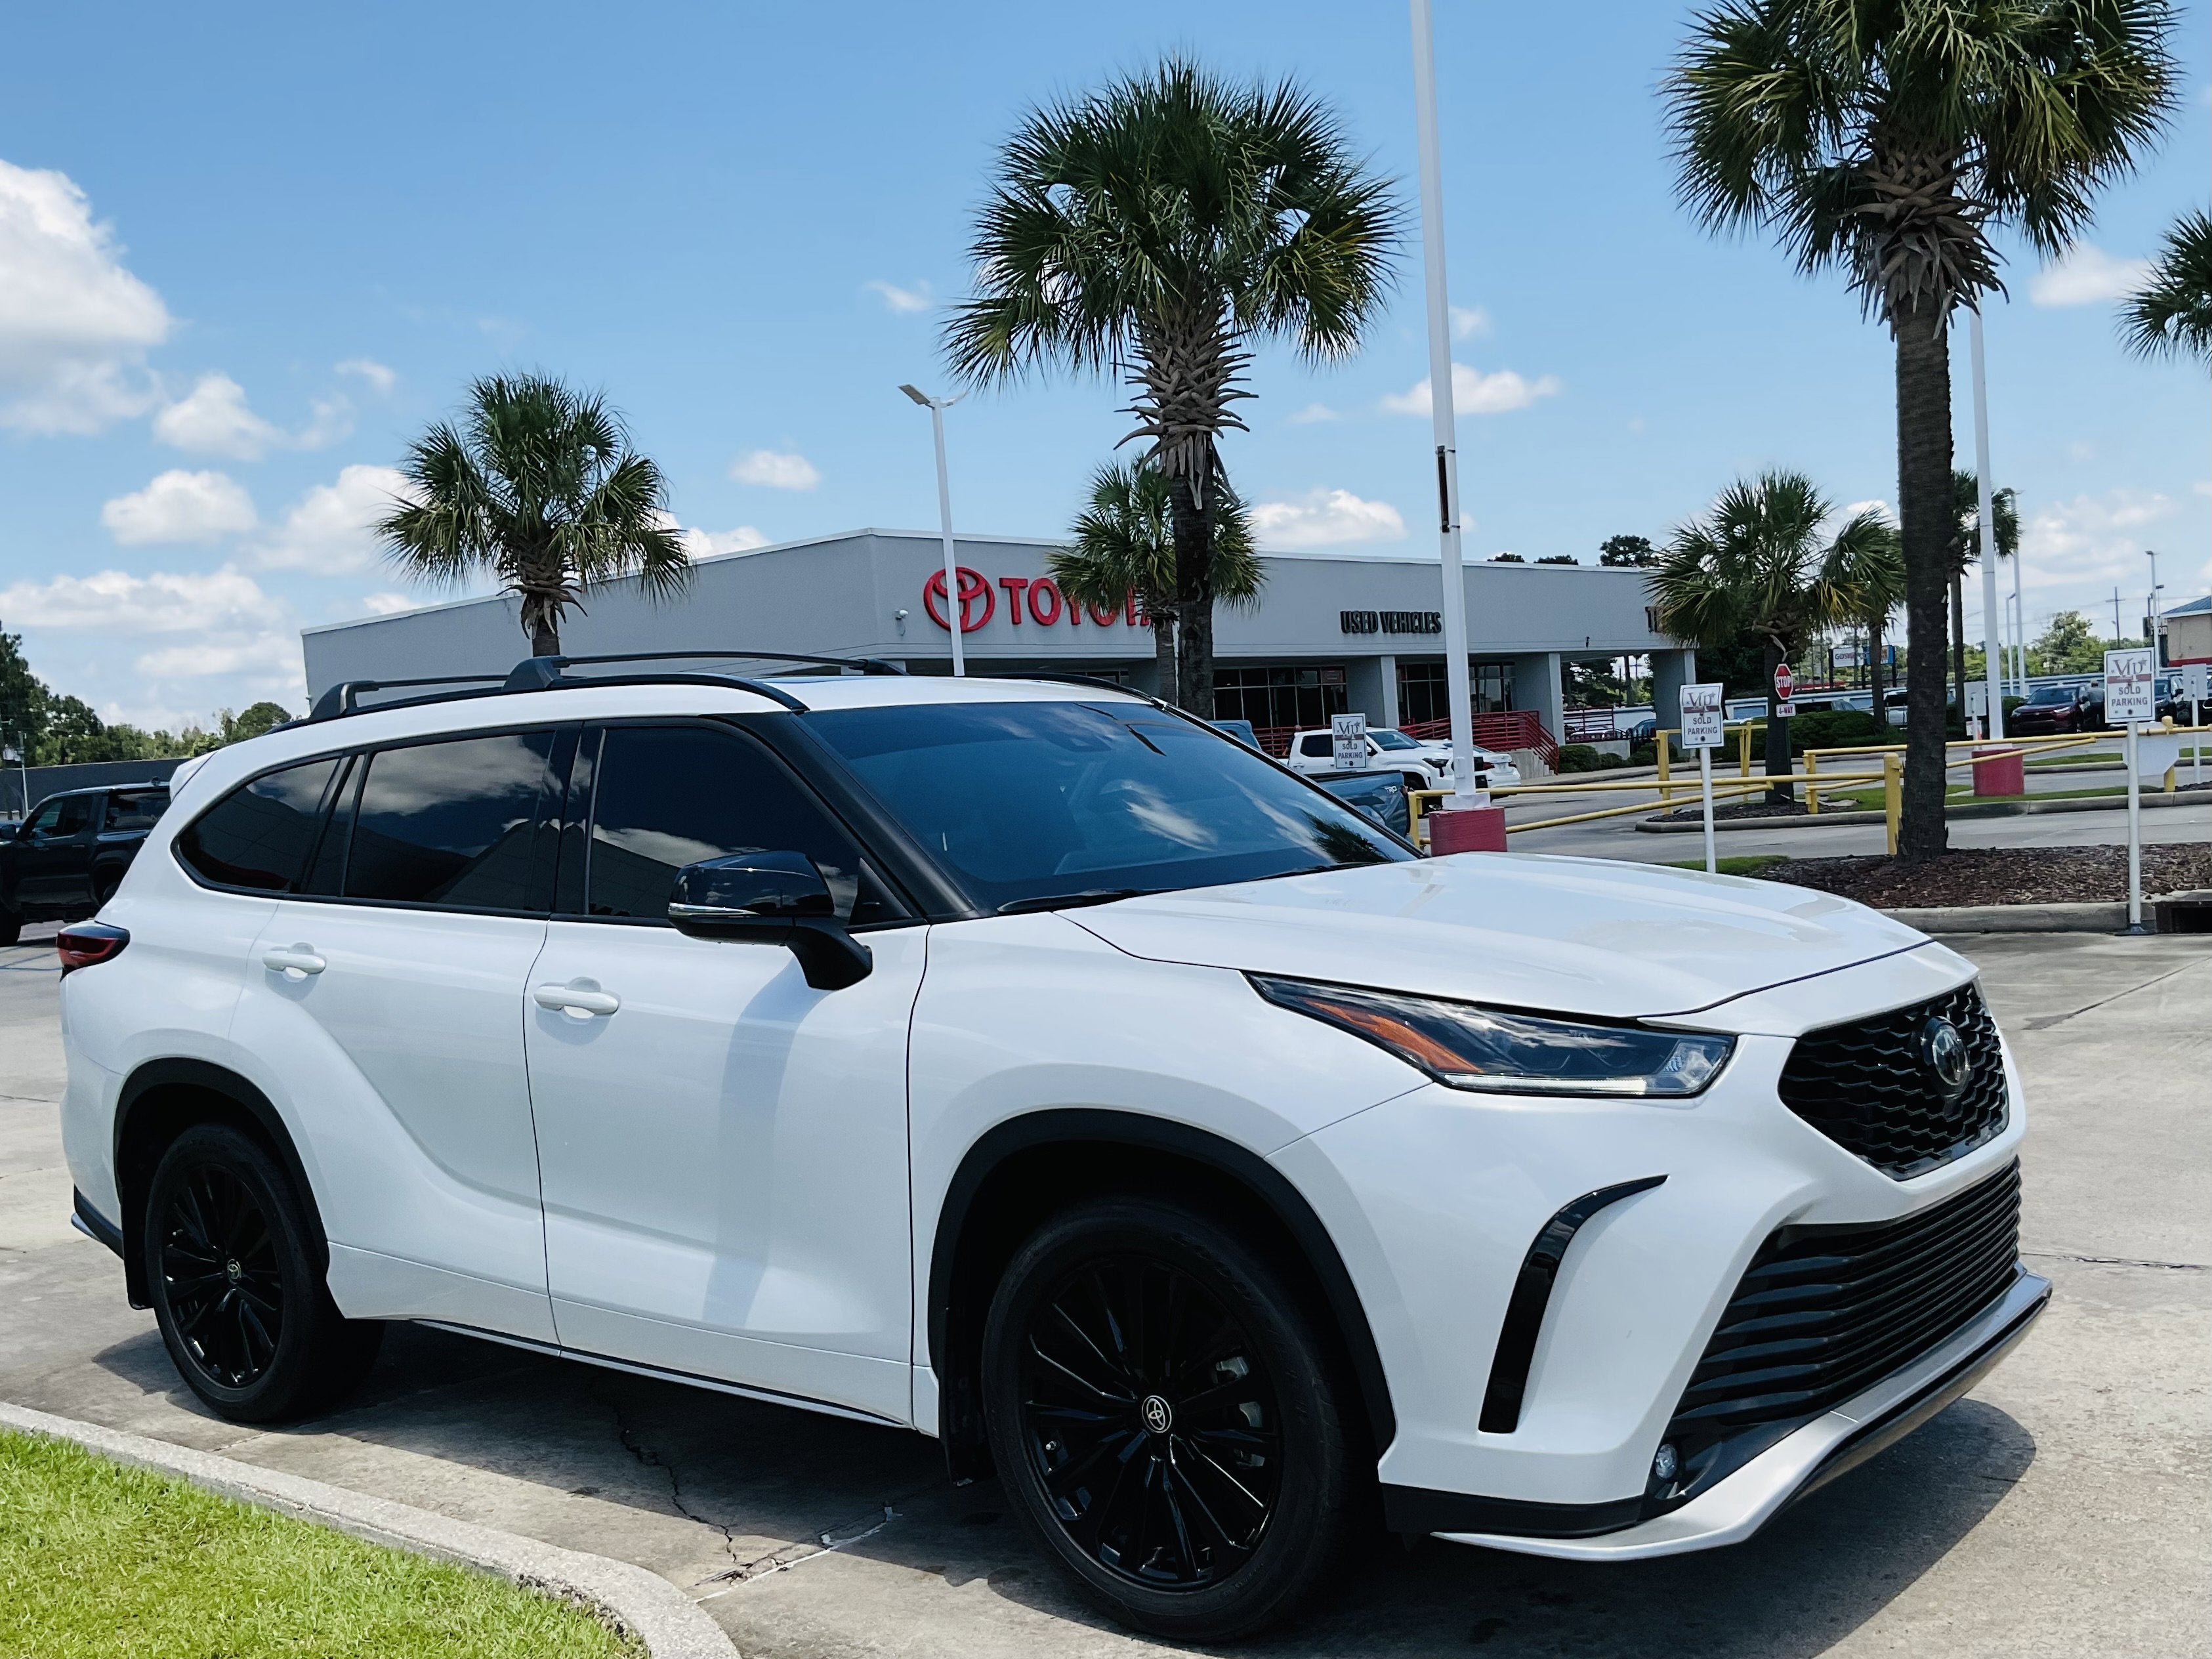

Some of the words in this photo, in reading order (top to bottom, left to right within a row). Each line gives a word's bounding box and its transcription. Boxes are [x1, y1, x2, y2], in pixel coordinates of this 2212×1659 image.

[1340, 610, 1378, 634] USED
[1379, 611, 1442, 634] VEHICLES
[1776, 675, 1791, 688] STOP
[2118, 686, 2141, 695] SOLD
[2111, 697, 2148, 707] PARKING
[1693, 717, 1711, 725] SOLD
[1687, 726, 1718, 735] PARKING
